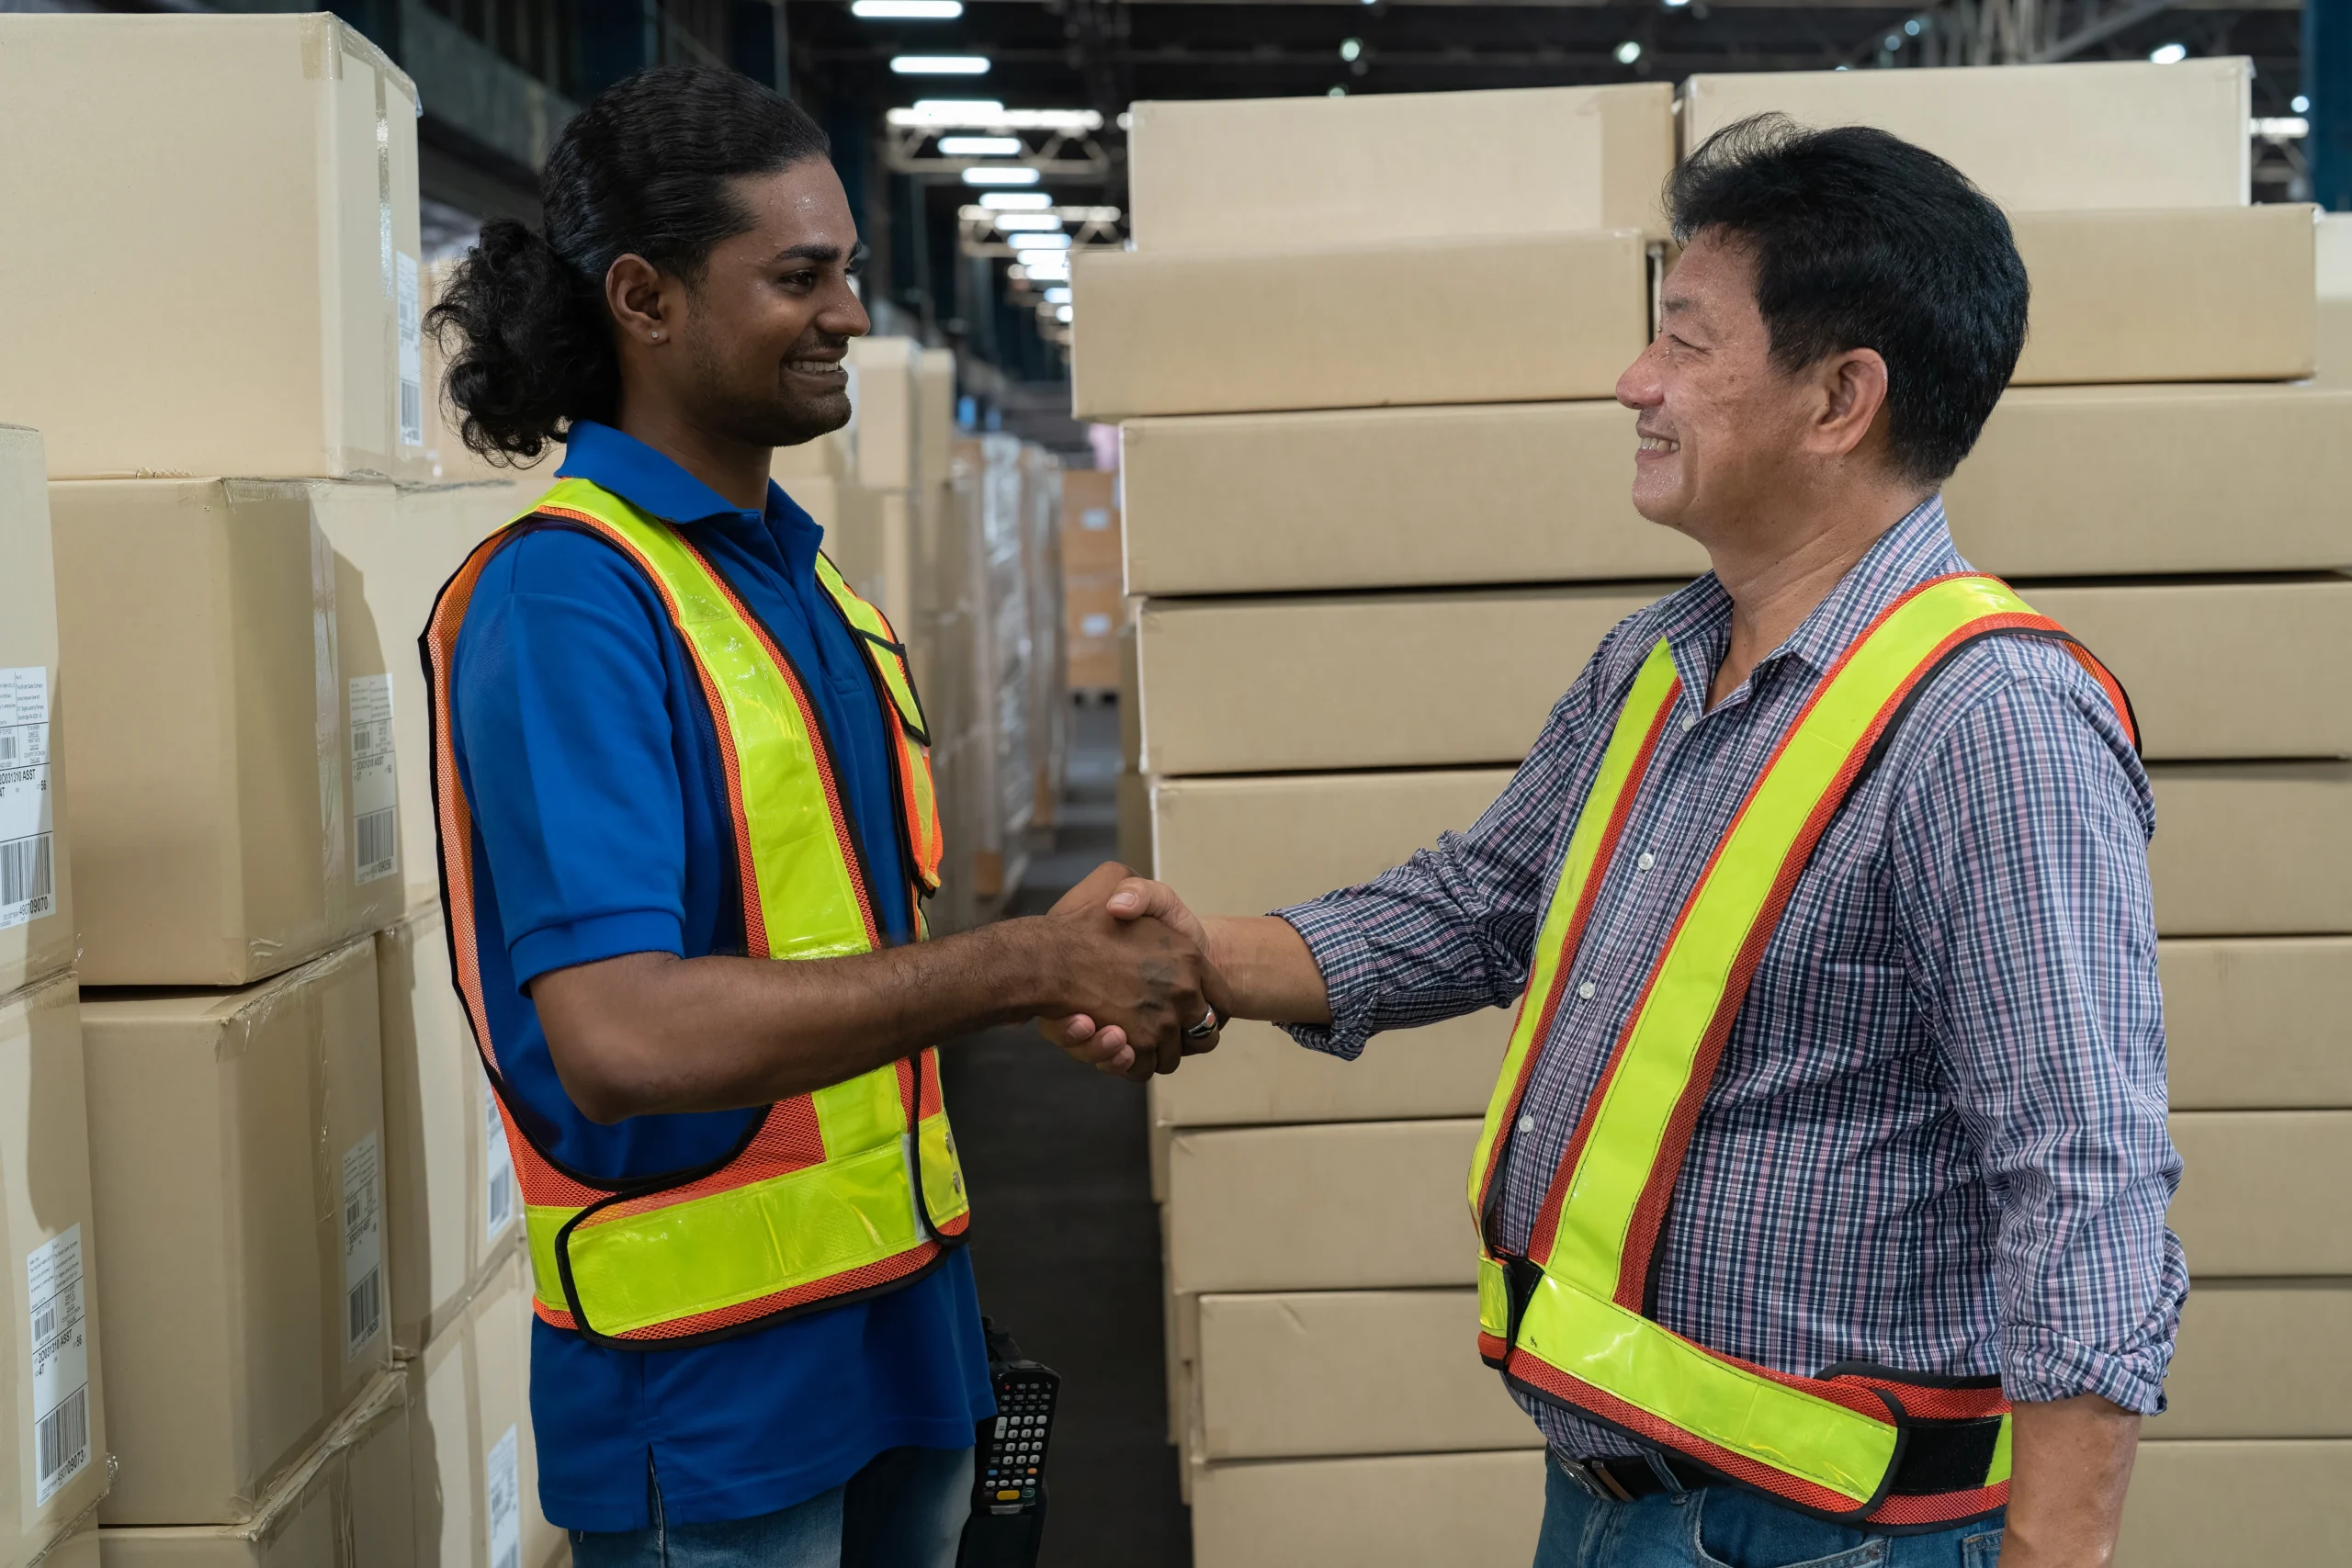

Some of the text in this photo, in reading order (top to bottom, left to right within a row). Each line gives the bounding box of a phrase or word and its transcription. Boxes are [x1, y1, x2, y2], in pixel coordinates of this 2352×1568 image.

[23, 769, 35, 781] ASST
[40, 779, 46, 790] 56
[60, 1328, 72, 1348] ASST
[76, 1335, 83, 1348] 56
